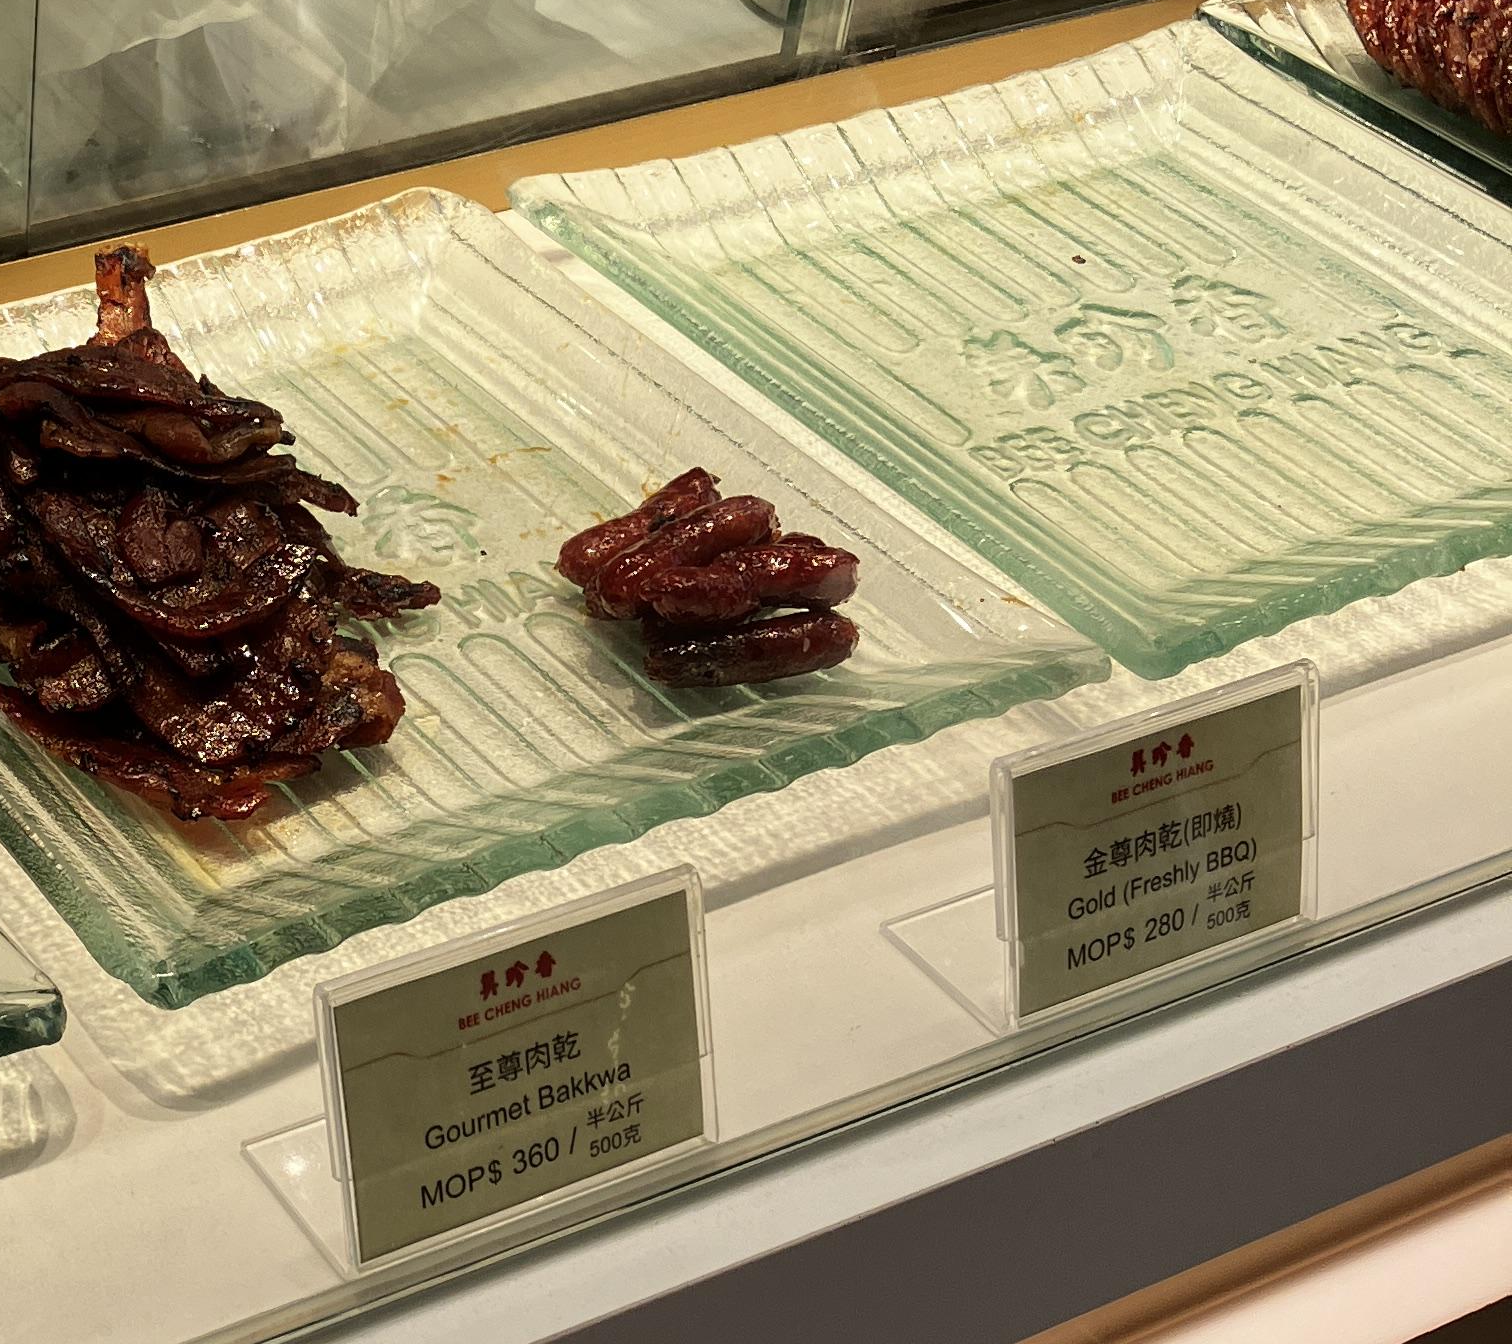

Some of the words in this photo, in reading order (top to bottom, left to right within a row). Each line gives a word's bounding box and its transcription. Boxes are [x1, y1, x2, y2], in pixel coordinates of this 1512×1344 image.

[1111, 787, 1130, 804] BEE
[1132, 772, 1173, 797] CHENG
[1175, 759, 1215, 783] HIANG
[1067, 885, 1116, 921] Gold
[1123, 859, 1200, 907] (Freshly
[1206, 837, 1258, 873] BBQ)
[1206, 869, 1256, 903] 半公斤
[1067, 926, 1136, 970] MOP$
[1144, 906, 1185, 943] 280
[1206, 899, 1251, 930] 500克
[458, 1013, 481, 1031] BEE
[484, 994, 533, 1022] CHENG
[536, 977, 582, 1005] HIANG
[468, 1030, 582, 1096] 至尊肉乾
[424, 1093, 533, 1150] Gourmet
[538, 1060, 632, 1110] Bakkwa
[587, 1092, 645, 1130] 半公斤
[590, 1123, 642, 1158] 500克
[421, 1159, 503, 1209] MOP$
[512, 1136, 560, 1176] 360
